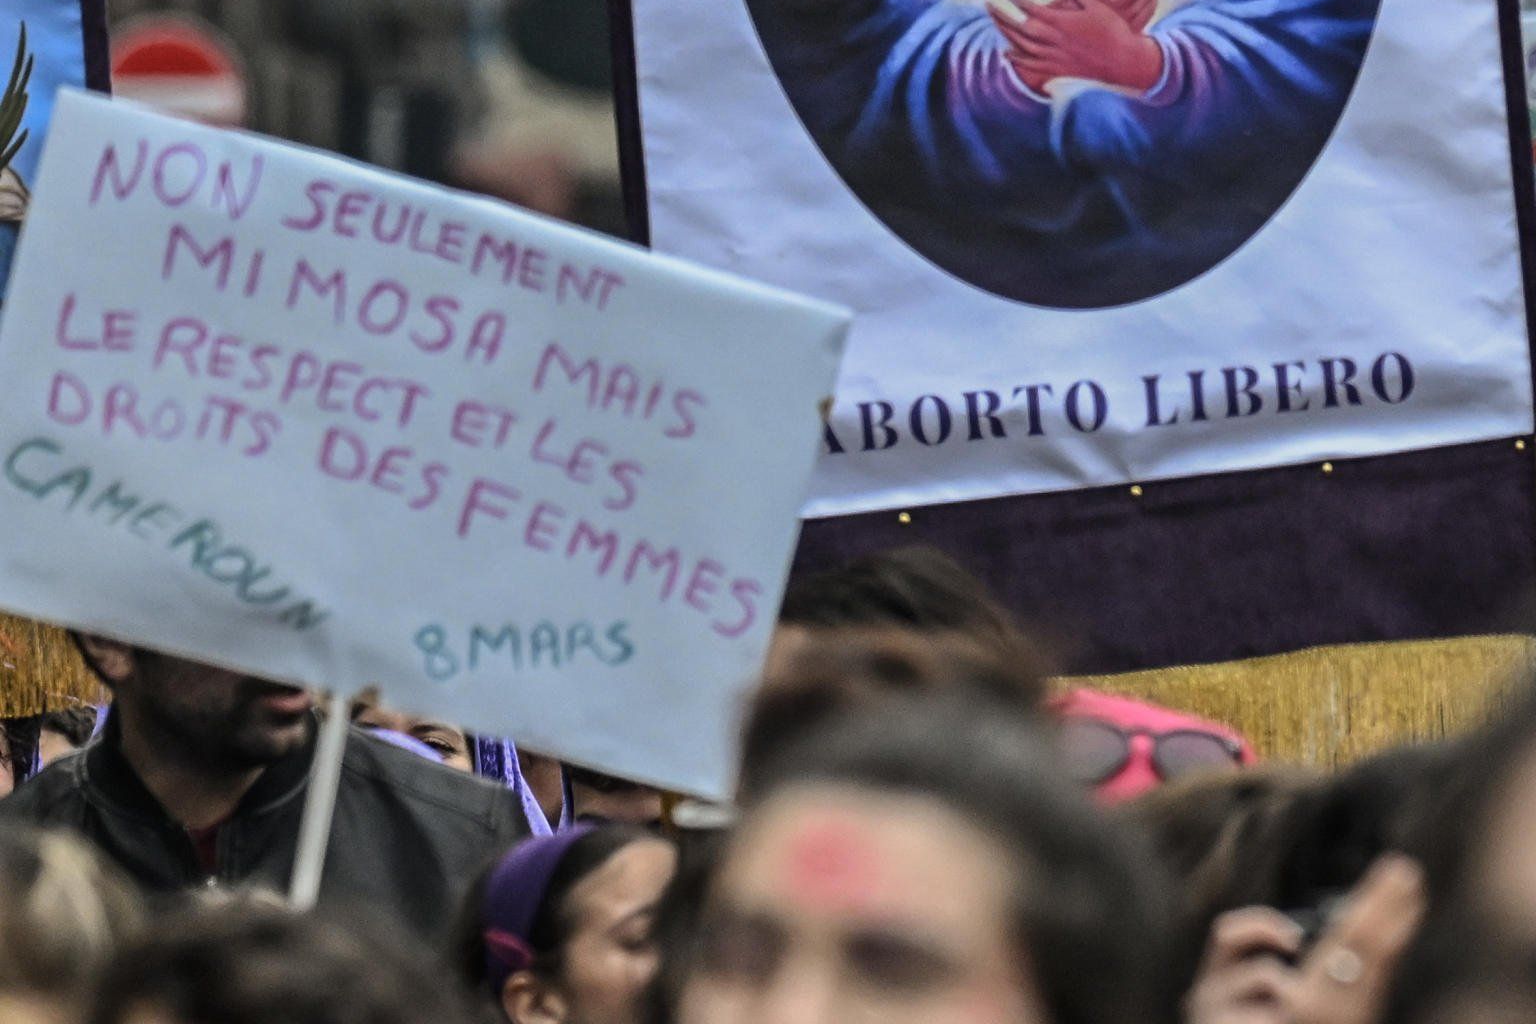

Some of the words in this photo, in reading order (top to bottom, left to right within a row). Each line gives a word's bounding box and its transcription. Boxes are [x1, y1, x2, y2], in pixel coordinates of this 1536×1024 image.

[89, 139, 264, 216] NON
[283, 181, 626, 308] SEULEMENT
[153, 318, 429, 432] RESPECT
[529, 425, 643, 513] LES
[162, 225, 505, 364] MIMOSA
[532, 341, 707, 439] MAIS
[1141, 351, 1415, 428] LIBERO
[4, 436, 331, 633] CAMEROUN
[47, 371, 283, 458] DROITS
[318, 429, 448, 510] DES
[457, 478, 763, 638] FEMMES
